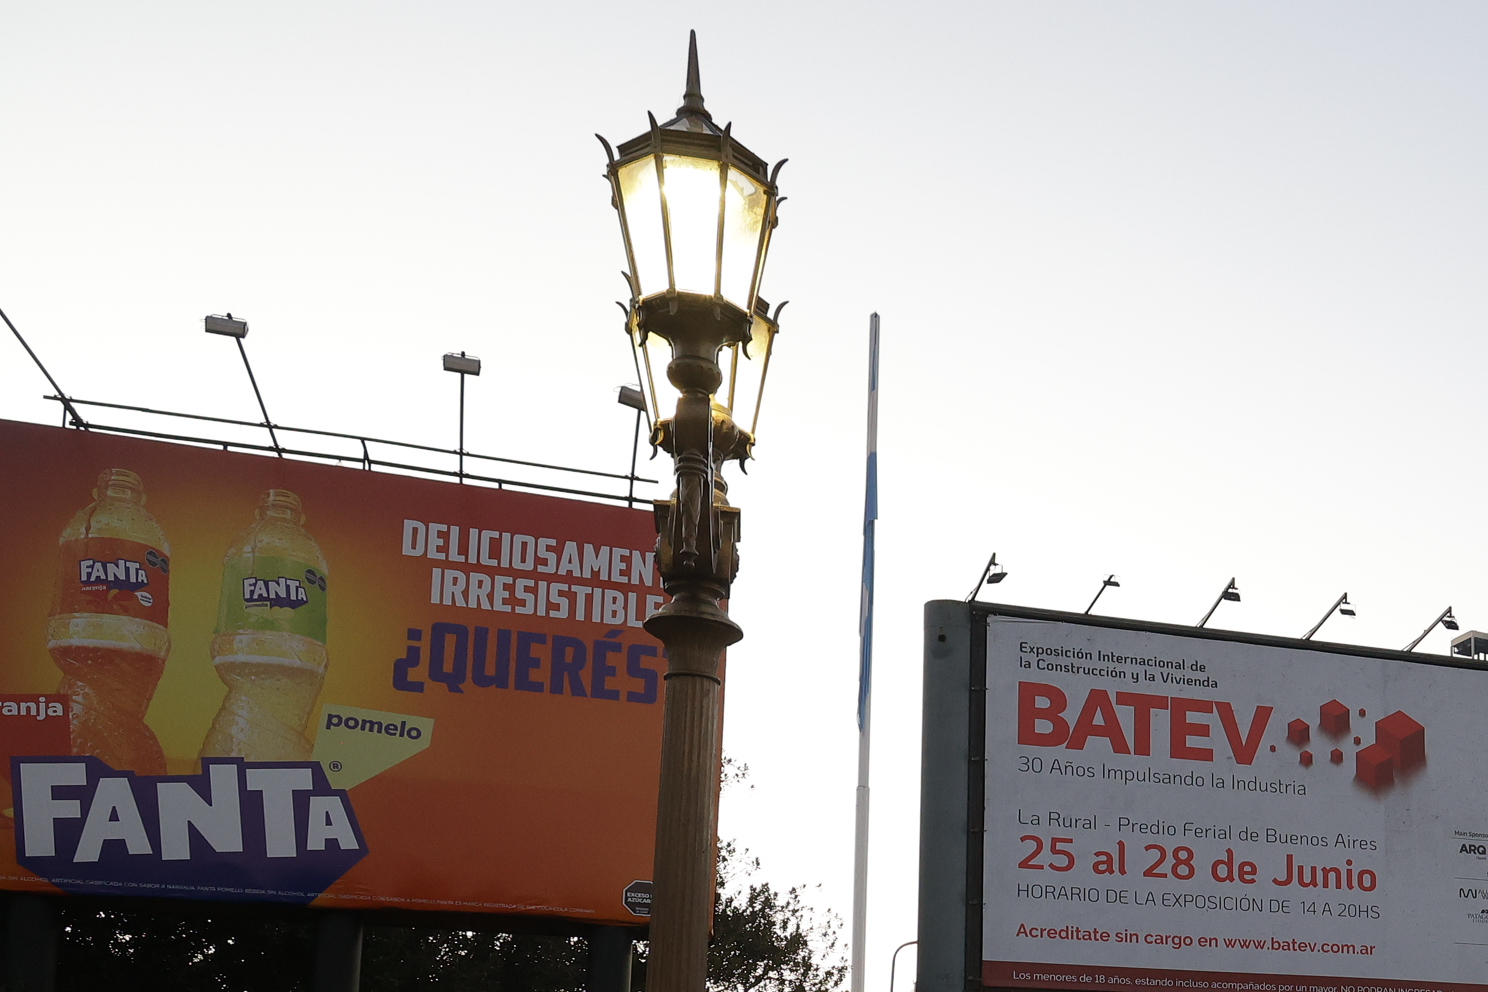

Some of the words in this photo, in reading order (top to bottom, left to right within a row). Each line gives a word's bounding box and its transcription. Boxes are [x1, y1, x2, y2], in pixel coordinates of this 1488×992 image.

[402, 519, 664, 588] DELICIOSAMEN
[80, 559, 148, 584] FANTA
[243, 577, 308, 601] FANTA
[392, 622, 668, 704] ¿QUERÉS
[1020, 642, 1092, 661] Exposición
[1098, 650, 1185, 671] Internacional
[1190, 660, 1206, 672] de
[1020, 656, 1031, 669] la
[1037, 659, 1126, 680] Construcción
[1131, 671, 1140, 683] y
[1145, 669, 1155, 682] la
[1161, 672, 1218, 689] Vivienda
[0, 697, 63, 720] anja
[1017, 681, 1274, 766] BATEV
[325, 712, 422, 740] pomelo
[1018, 755, 1043, 773] 30
[1050, 759, 1095, 778] Años
[1102, 763, 1205, 787] Impulsando
[1211, 773, 1225, 788] la
[1232, 775, 1307, 795] Industria
[20, 763, 359, 862] FANTA
[1018, 809, 1040, 826] La
[1048, 811, 1097, 830] Rural
[1118, 816, 1176, 836] Predio
[1183, 822, 1232, 841] Ferial
[1238, 825, 1259, 843] de
[1266, 828, 1328, 847] Buenos
[1335, 833, 1378, 851] Aires
[1018, 834, 1075, 873] 25
[1092, 839, 1126, 877] al
[1143, 843, 1195, 881] 28
[1211, 847, 1258, 885] de
[1271, 853, 1377, 892] Junio
[1459, 843, 1487, 855] ARQ
[1017, 883, 1100, 904] HORARIO
[1106, 889, 1129, 905] DE
[1134, 891, 1156, 907] LA
[1162, 892, 1263, 913] EXPOSICIÓN
[1269, 899, 1291, 915] DE
[1300, 900, 1317, 916] 14
[1322, 902, 1333, 917] A
[1338, 903, 1380, 920] 20HS
[1016, 923, 1111, 943] Acreditate
[1115, 928, 1139, 944] sin
[1144, 932, 1193, 950] cargo
[1198, 936, 1219, 948] en
[1223, 937, 1376, 956] www.batev.com.ar
[1013, 970, 1031, 981] Los
[1033, 972, 1077, 983] menores
[1079, 973, 1092, 983] de
[1095, 974, 1106, 984] 18
[1135, 977, 1174, 987] estando
[1176, 978, 1209, 989] incluso
[1211, 981, 1276, 992] acompañados
